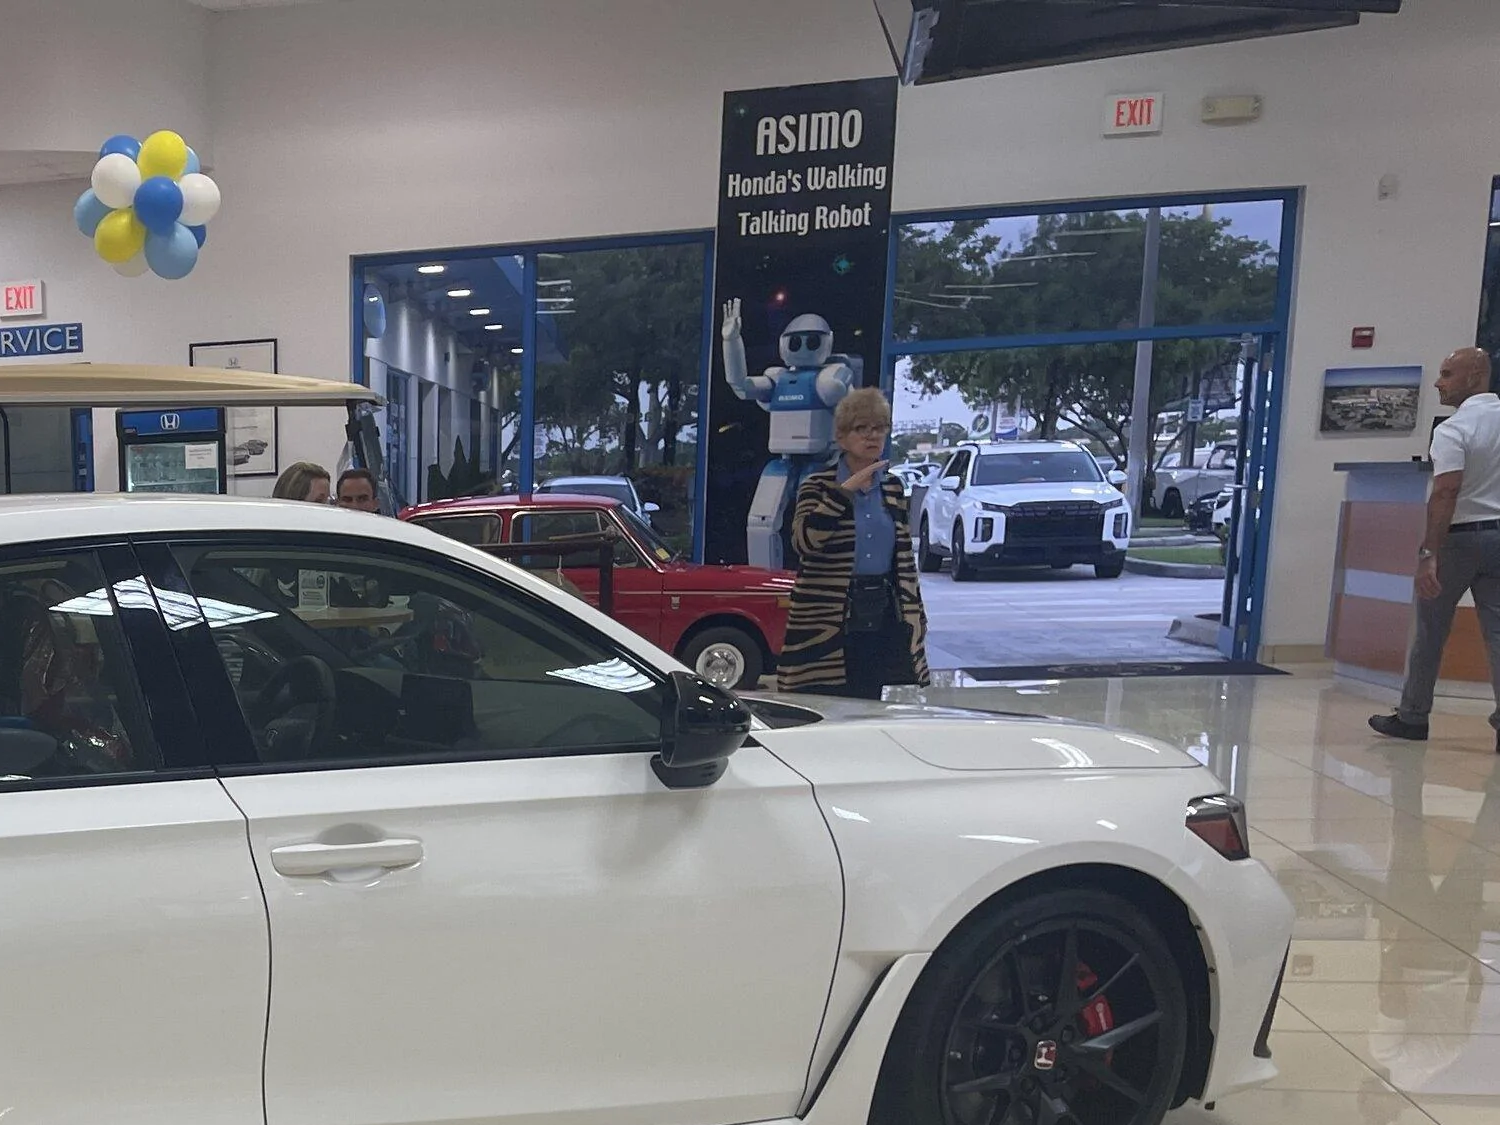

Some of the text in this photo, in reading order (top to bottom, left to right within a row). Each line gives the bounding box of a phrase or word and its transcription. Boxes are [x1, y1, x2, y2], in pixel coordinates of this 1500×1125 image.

[1115, 98, 1155, 127] EXIT
[756, 109, 863, 156] ASIMO
[727, 163, 887, 198] Honda's Walking
[738, 202, 872, 236] Talking Robot
[5, 285, 36, 311] EXIT
